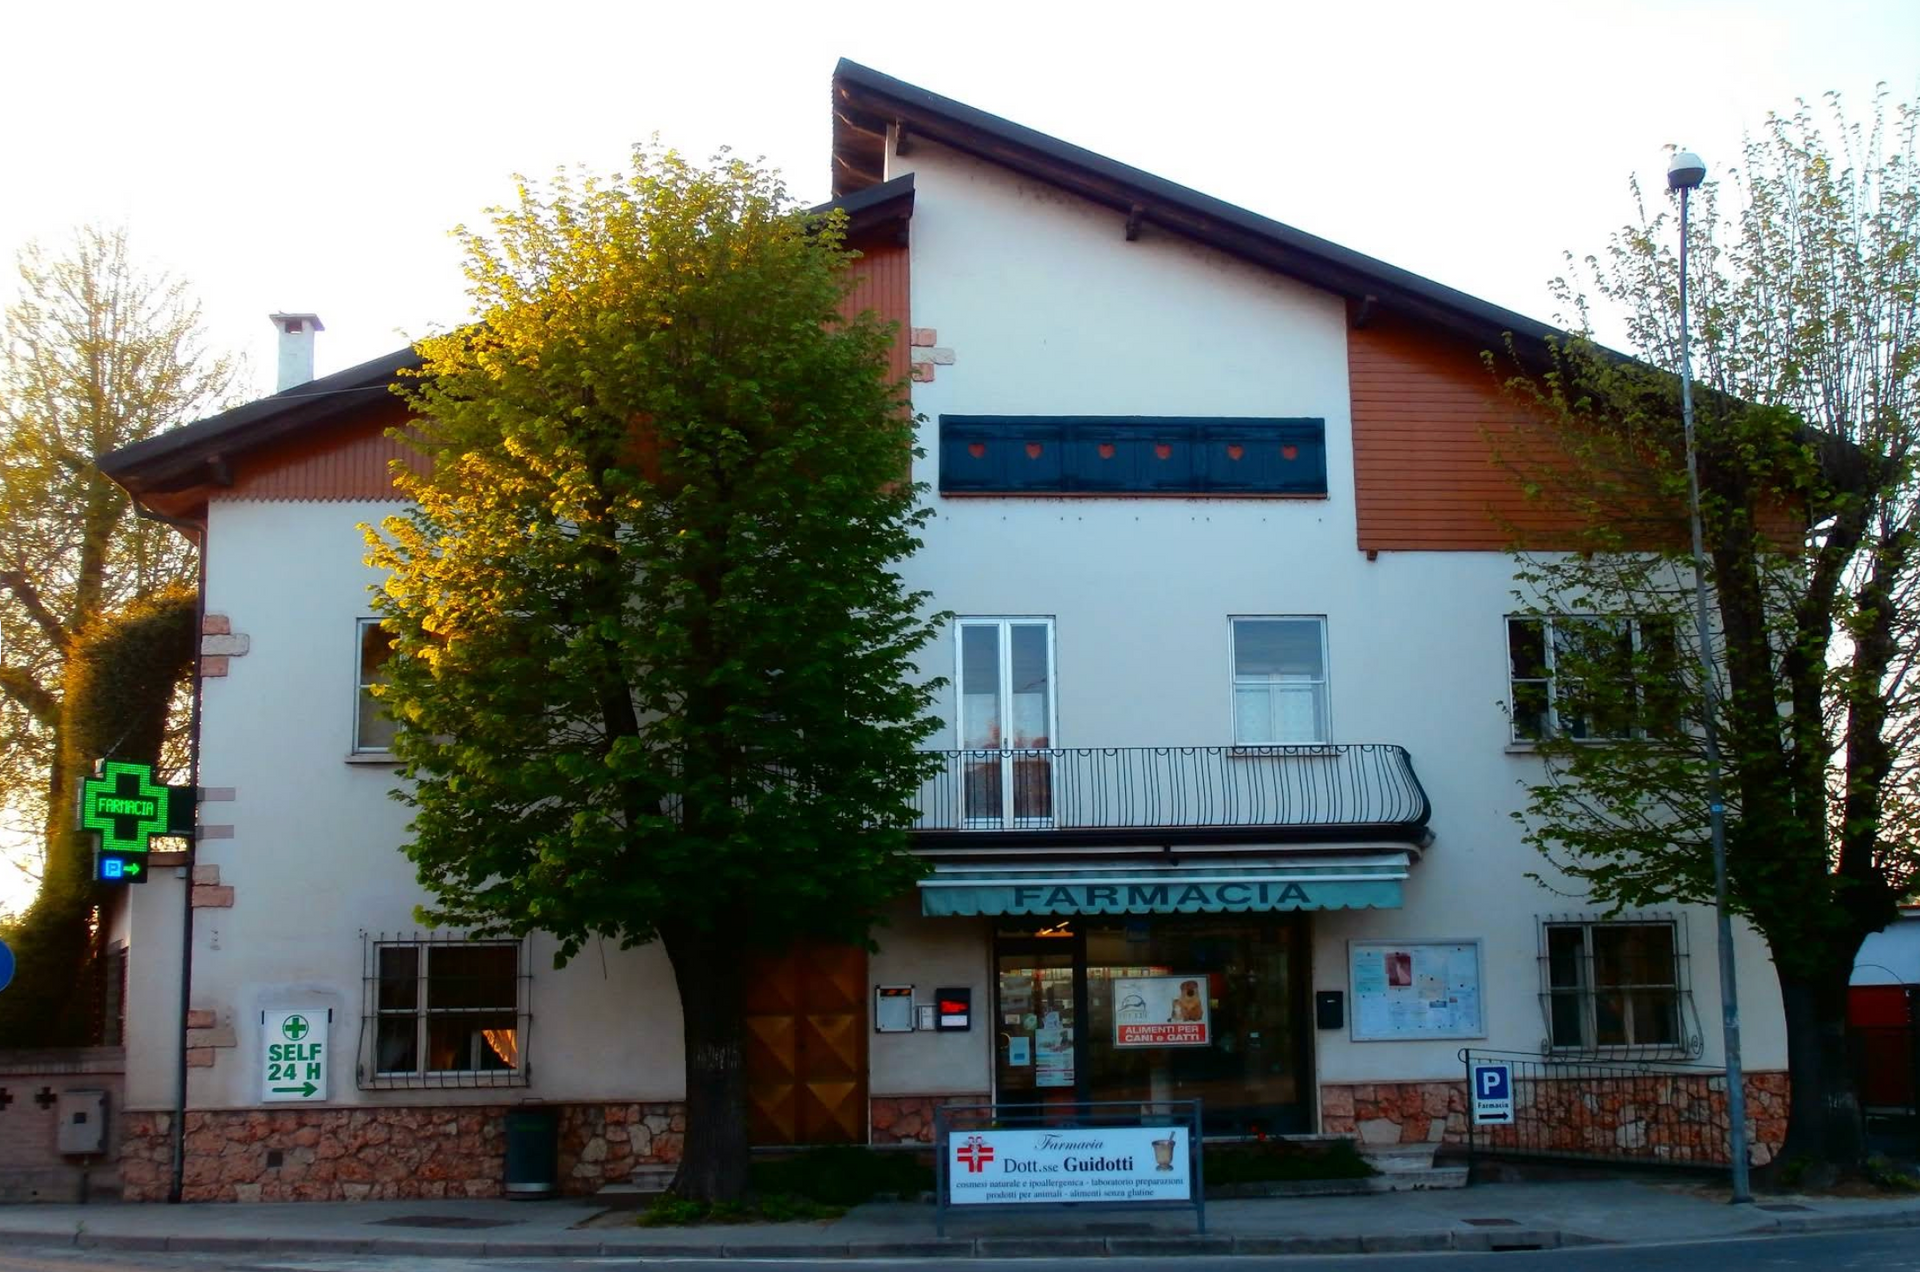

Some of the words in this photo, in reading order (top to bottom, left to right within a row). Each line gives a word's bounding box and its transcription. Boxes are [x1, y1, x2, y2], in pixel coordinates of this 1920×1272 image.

[98, 798, 154, 816] FARMACIA
[1014, 883, 1311, 907] FARMACIA
[1125, 1026, 1175, 1034] ALIMENTI
[1177, 1025, 1199, 1033] PER
[1125, 1034, 1153, 1042] CANI
[268, 1043, 322, 1062] SELF
[267, 1063, 297, 1081] 24
[306, 1062, 321, 1080] H
[1483, 1072, 1501, 1095] P
[1477, 1101, 1509, 1109] Farmacia
[1035, 1133, 1104, 1151] Farmacia
[1003, 1157, 1059, 1173] Dott.sse
[1063, 1156, 1134, 1172] Guidotti
[956, 1180, 987, 1188] cosmesi
[989, 1179, 1019, 1188] naturale
[1029, 1179, 1084, 1189] ipoallergenica
[1091, 1178, 1134, 1187] laboratorio
[1135, 1178, 1184, 1187] preparazioni
[986, 1190, 1016, 1200] prodotti
[1019, 1191, 1031, 1200] per
[1033, 1190, 1062, 1198] animali
[1070, 1189, 1101, 1197] alimenti
[1127, 1188, 1154, 1198] glutine
